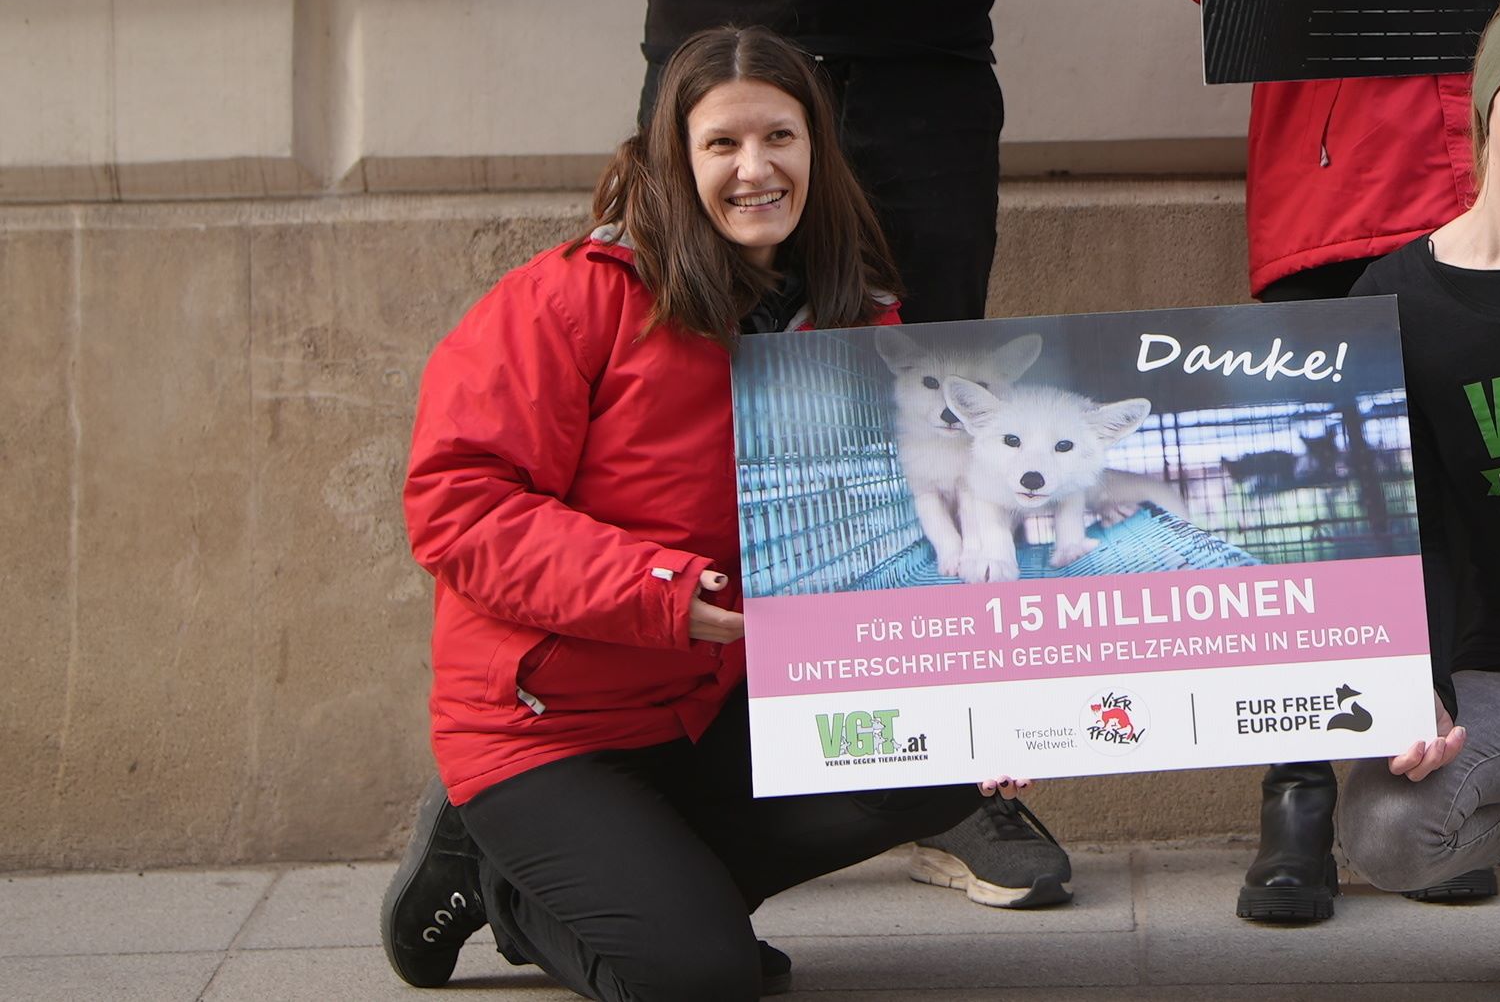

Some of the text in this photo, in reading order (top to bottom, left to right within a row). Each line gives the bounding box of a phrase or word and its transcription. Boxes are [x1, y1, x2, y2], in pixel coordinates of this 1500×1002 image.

[1137, 333, 1348, 383] Danke!
[856, 577, 1316, 643] FÜR ÜBER 1,5 MILLIONEN
[788, 624, 1391, 682] UNTERSCHRIFTEN GEGEN PELZFARMEN IN EUROPA
[1236, 695, 1335, 716] FUR FREE
[1015, 726, 1077, 739] Tierschutz.
[1237, 714, 1321, 734] EUROPE
[1025, 737, 1078, 751] Weltweit.
[1087, 726, 1146, 744] PFOTEN
[825, 759, 851, 767] VEREIN
[878, 754, 929, 763] TIERFABRIKEN
